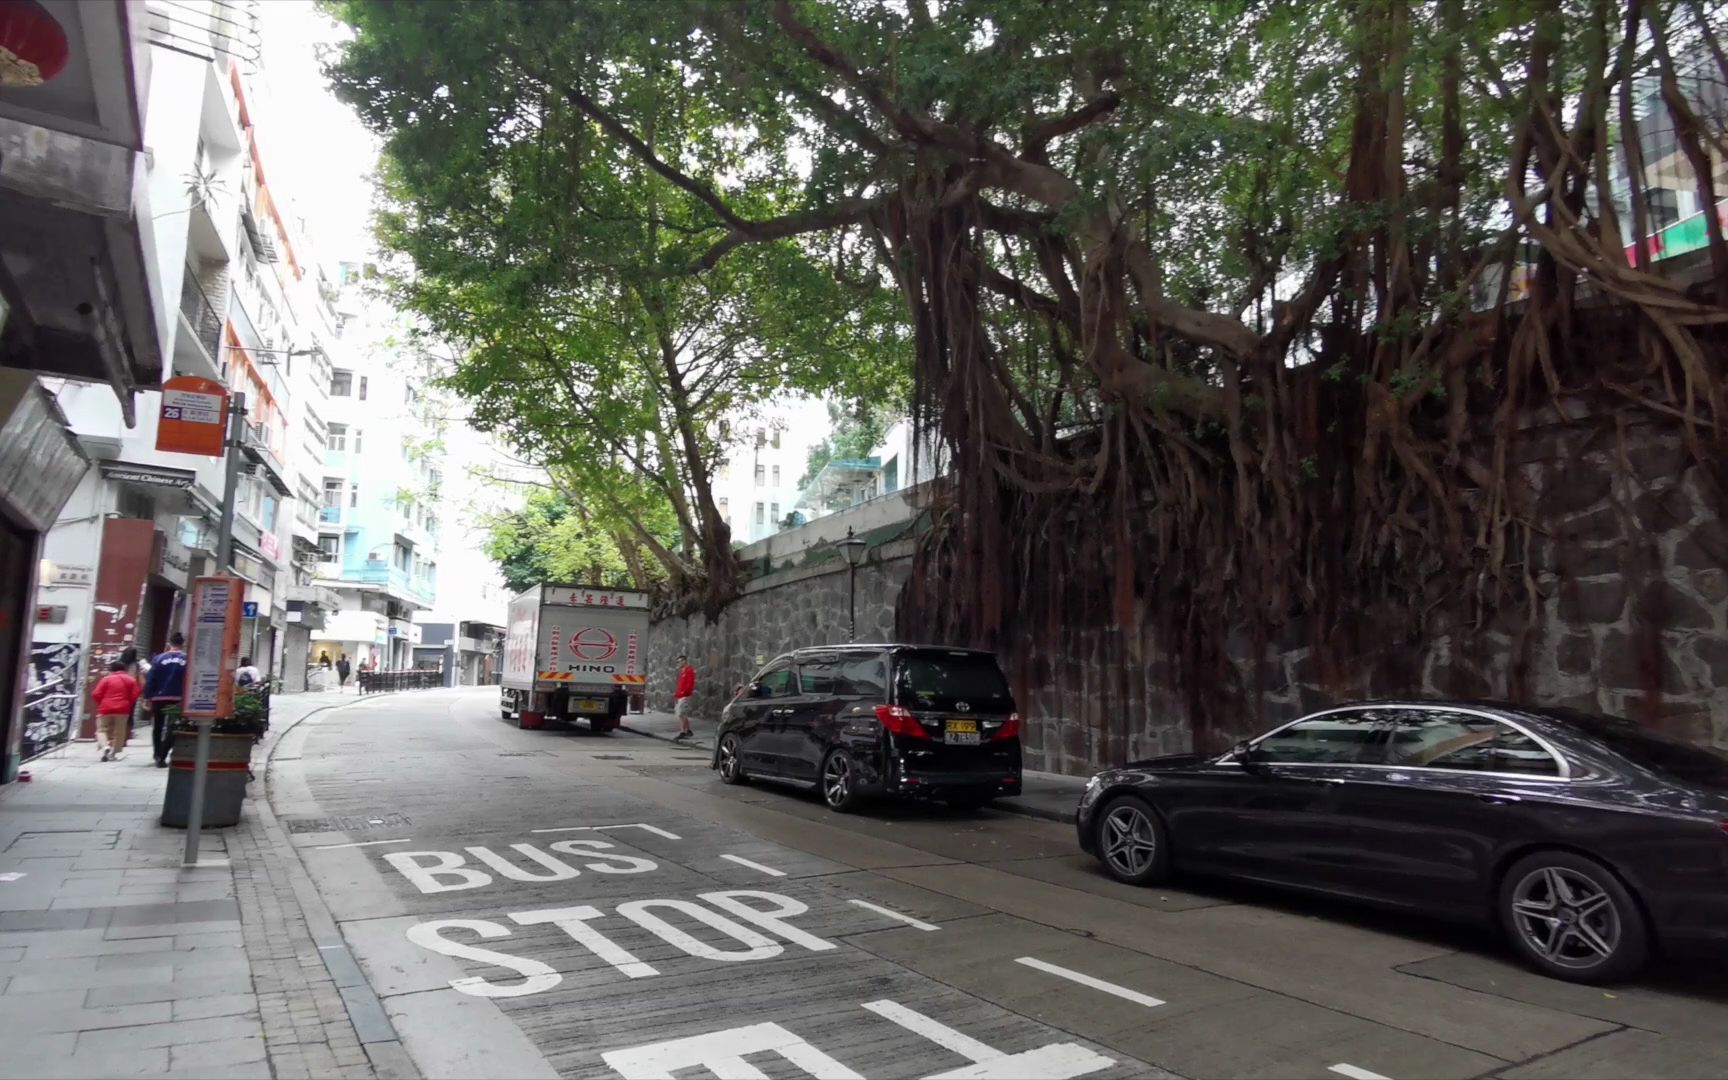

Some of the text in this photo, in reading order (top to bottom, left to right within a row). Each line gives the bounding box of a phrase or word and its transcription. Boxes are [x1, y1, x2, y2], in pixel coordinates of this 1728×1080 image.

[164, 407, 180, 420] 26
[141, 473, 174, 484] Chinese
[568, 664, 615, 673] HINO
[382, 839, 658, 894] BUS
[405, 890, 838, 998] STOP
